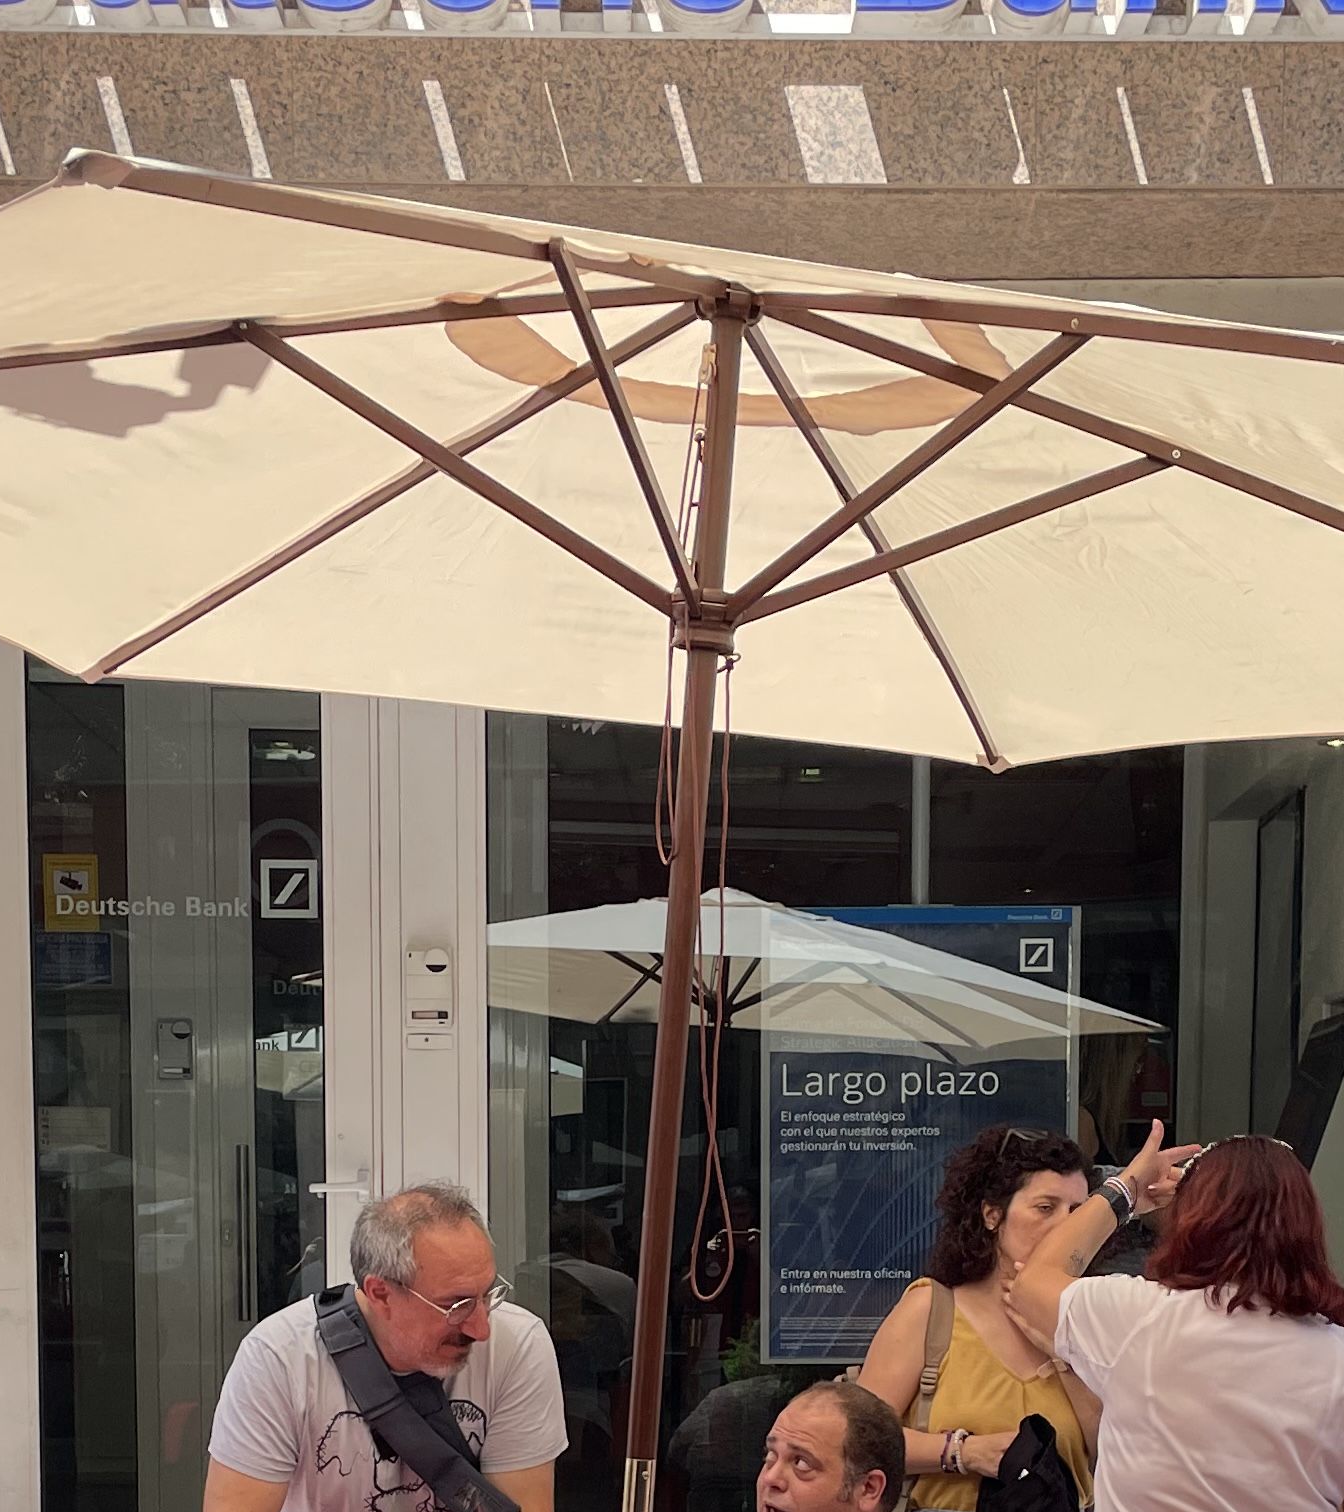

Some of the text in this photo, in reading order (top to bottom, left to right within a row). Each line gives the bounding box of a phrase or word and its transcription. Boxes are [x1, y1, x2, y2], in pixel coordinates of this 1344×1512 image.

[56, 895, 249, 918] Deutsche Bank
[782, 1062, 1000, 1105] Largo plazo
[780, 1110, 906, 1124] El enfoque estratégico
[780, 1126, 941, 1139] con el que nuestros expertos
[780, 1140, 917, 1154] gestionarán tu inversión.
[780, 1267, 912, 1279] Entra en nuestra oficina
[780, 1282, 847, 1294] e infórmate.
